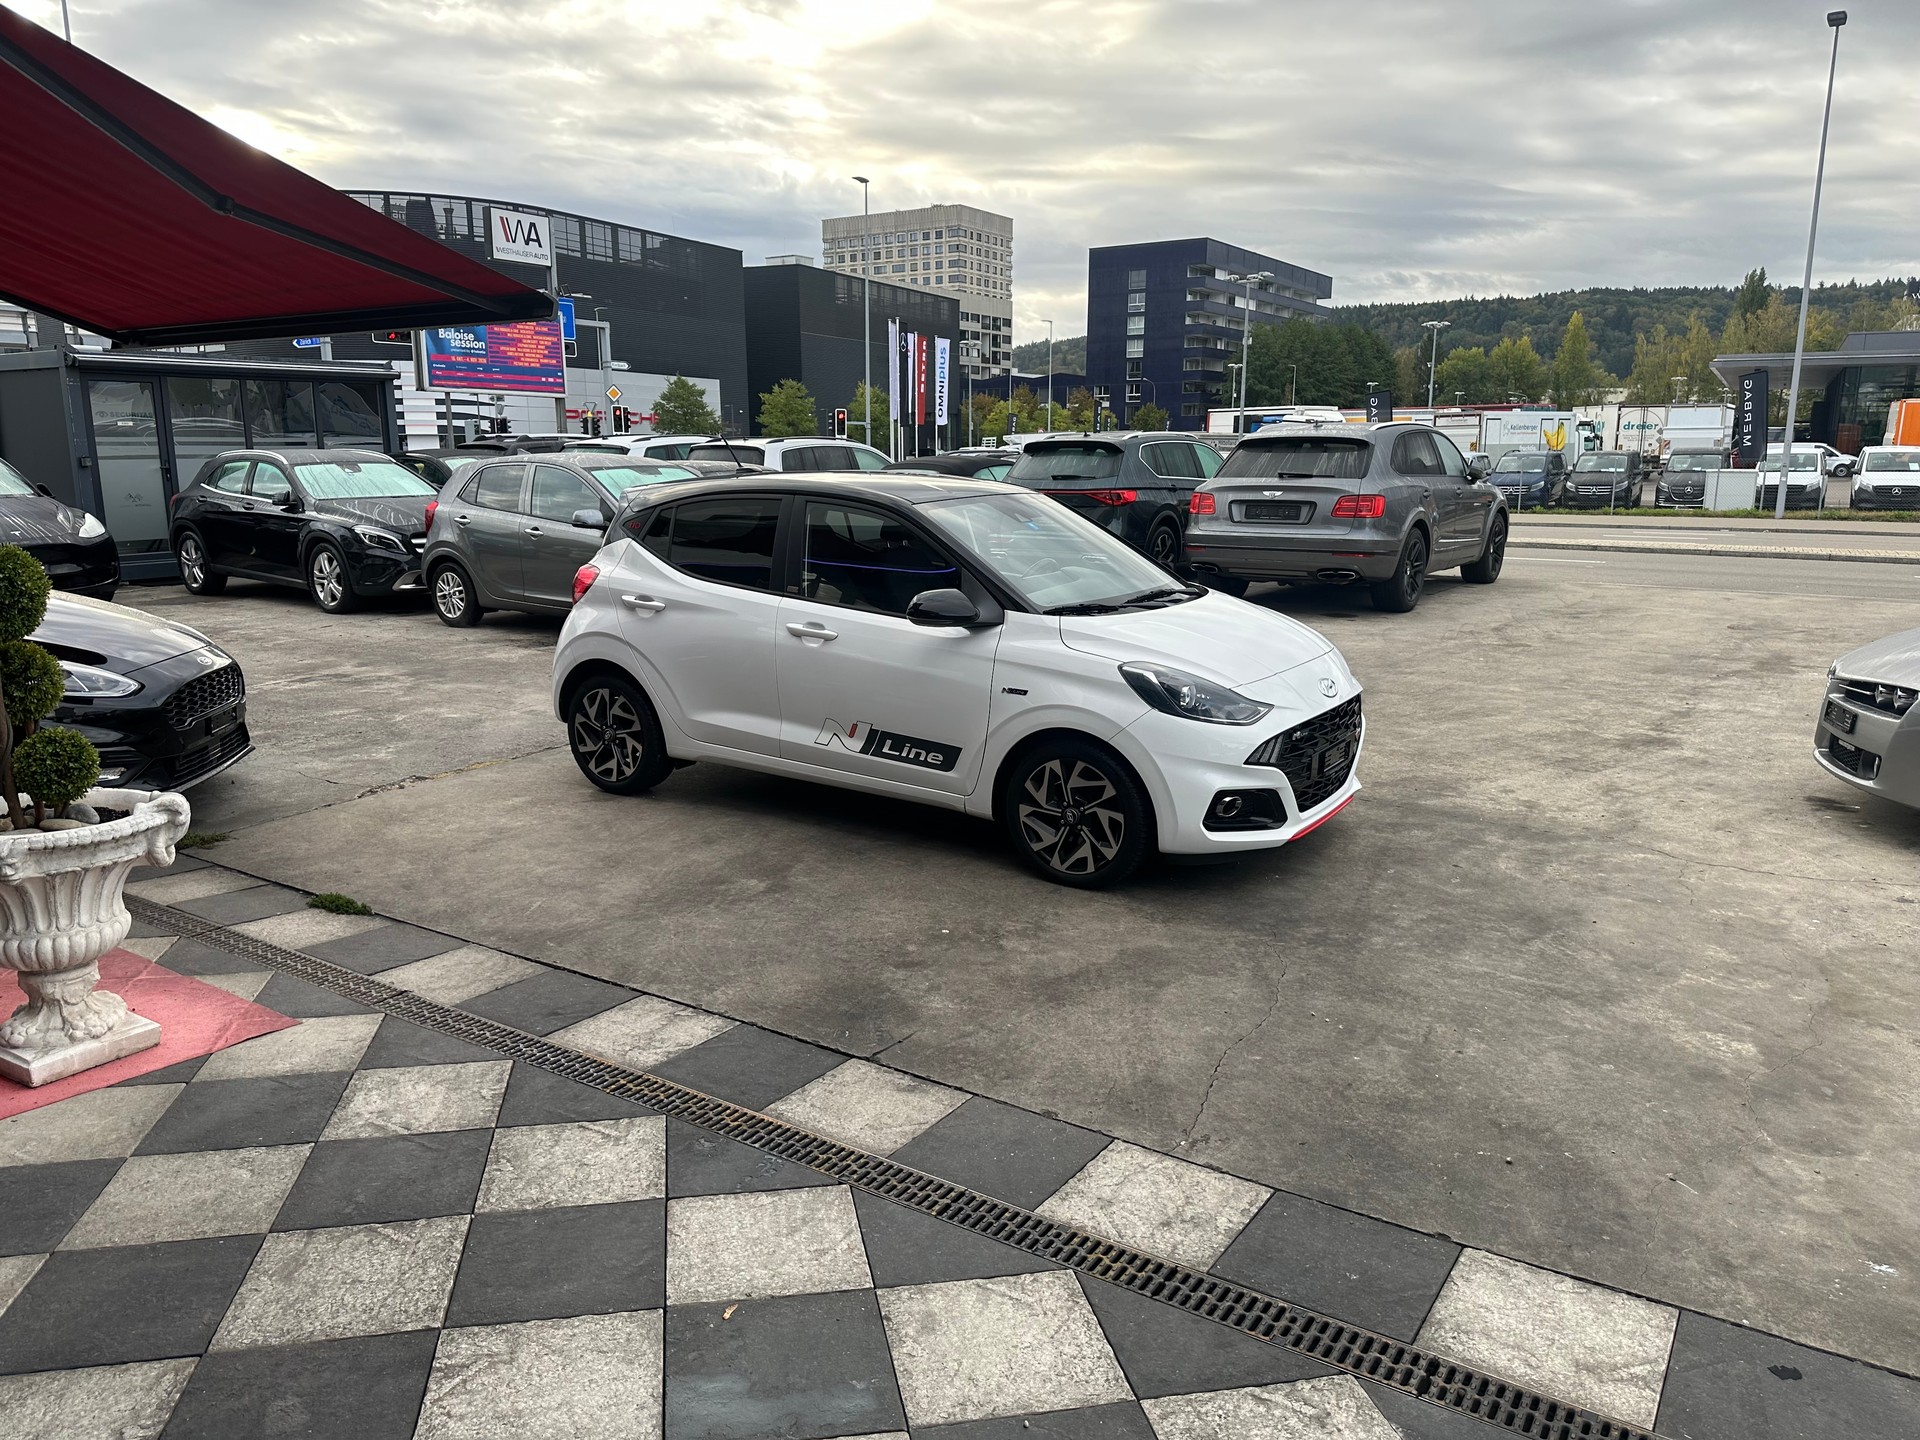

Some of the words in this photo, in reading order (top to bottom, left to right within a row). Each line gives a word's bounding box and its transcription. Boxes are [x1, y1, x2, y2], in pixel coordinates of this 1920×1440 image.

[438, 328, 474, 340] Baloise
[450, 340, 485, 349] session
[1623, 421, 1659, 430] dreier
[815, 717, 873, 753] N
[882, 739, 943, 765] Line
